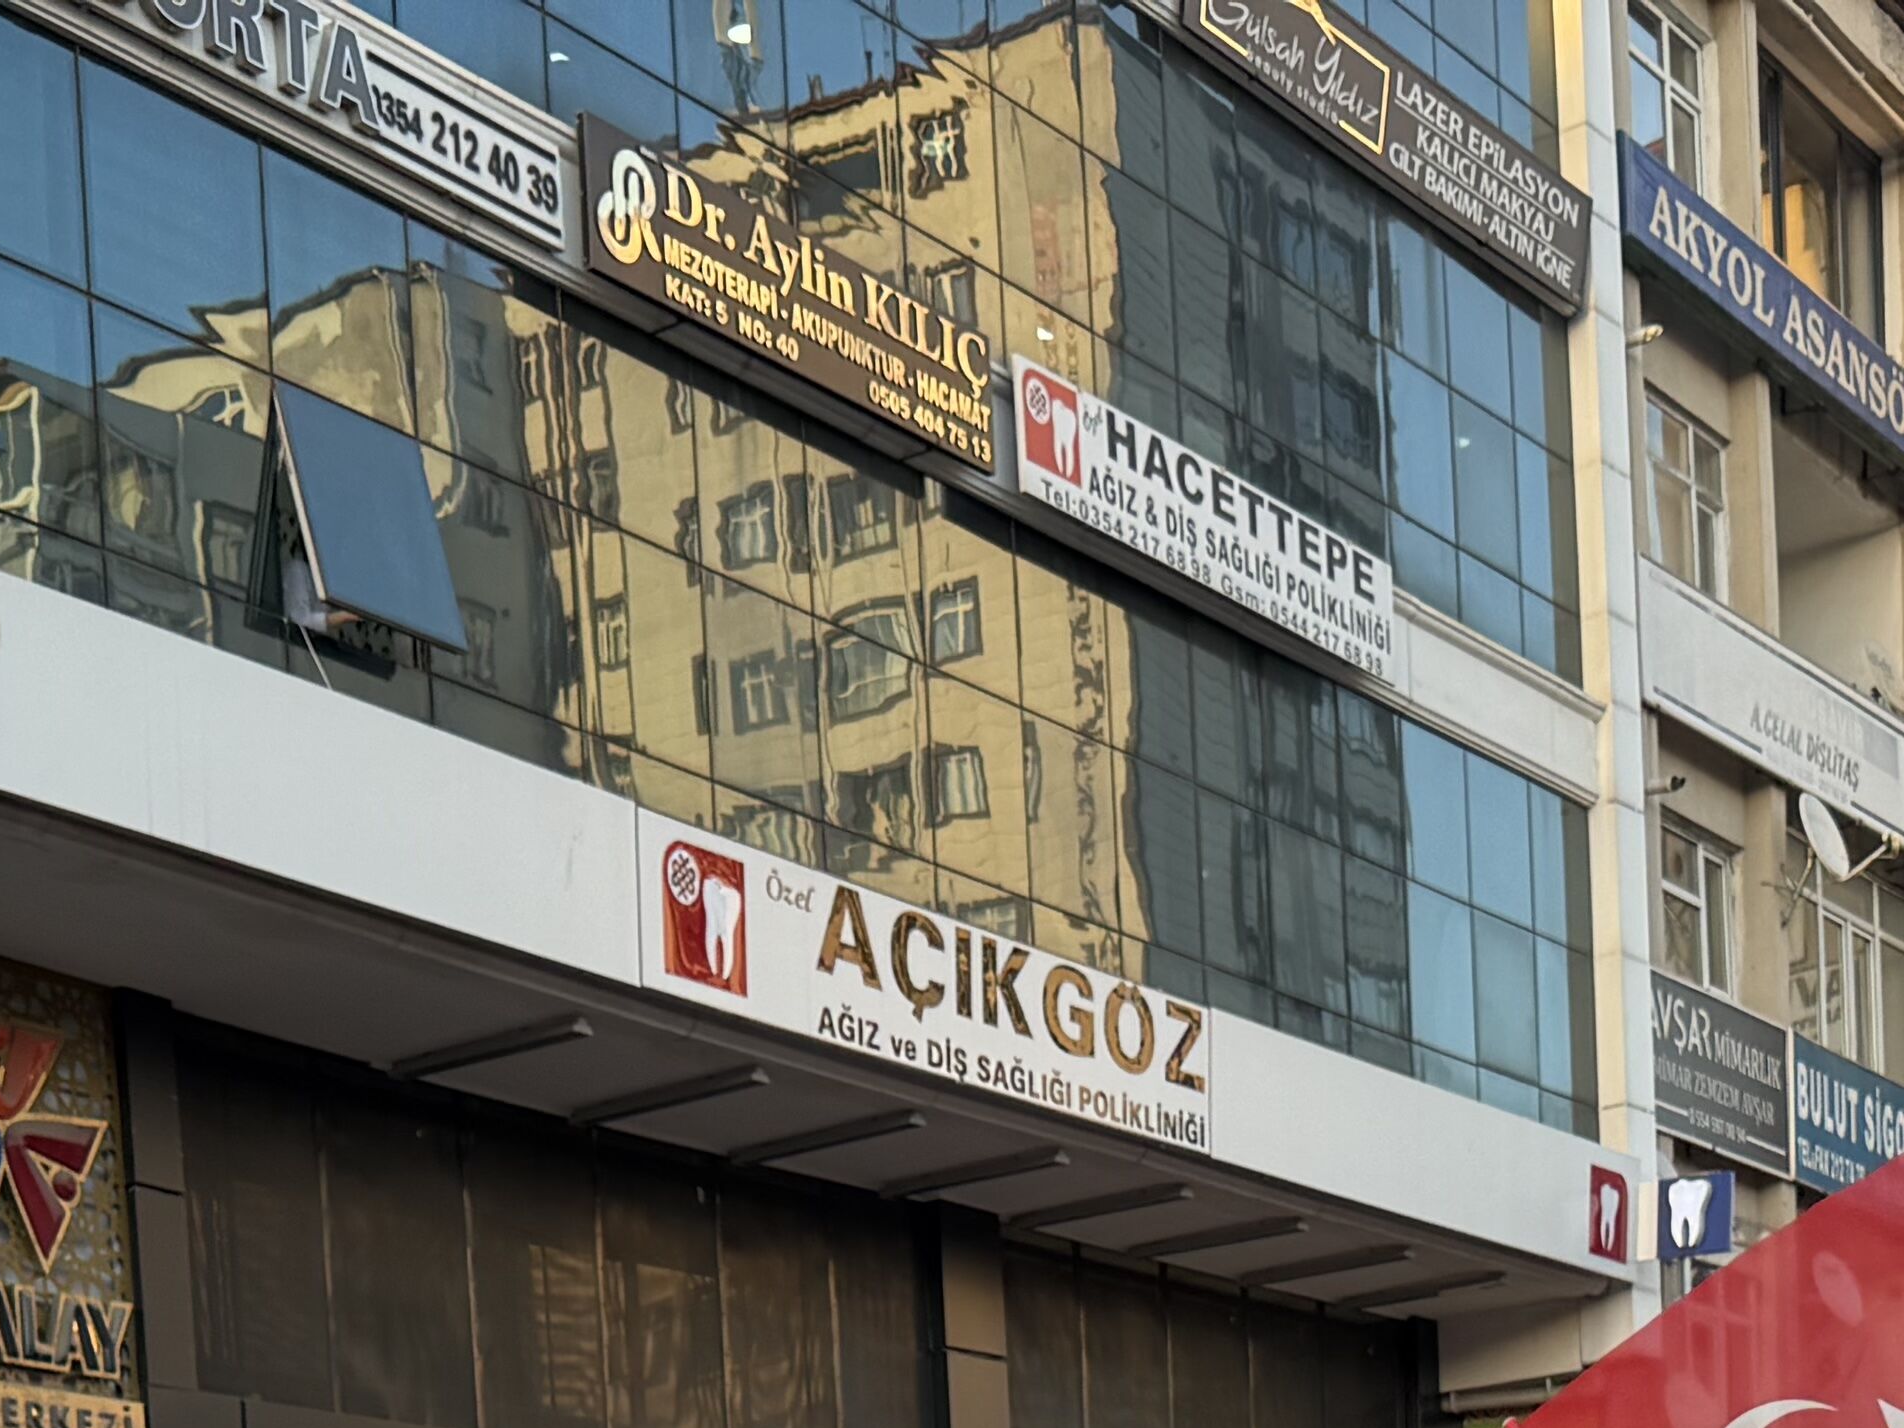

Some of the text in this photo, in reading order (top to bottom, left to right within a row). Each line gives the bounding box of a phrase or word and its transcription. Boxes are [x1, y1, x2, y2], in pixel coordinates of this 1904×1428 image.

[430, 111, 481, 175] 212
[487, 143, 520, 194] 40
[526, 164, 559, 214] 39
[1388, 142, 1421, 181] CİLT
[1424, 165, 1483, 226] BAKIMI
[1488, 215, 1534, 262] ALTIN
[1396, 71, 1580, 228] LAZER EPİLASYON
[1417, 124, 1556, 242] KALICI MAKYAJ
[661, 161, 989, 400] Dr. Aylin KILIÇ
[1649, 184, 1777, 329] AKYOL
[663, 234, 991, 433] MEZOTERAPİ AKUPUNKTUR HACAMAT
[716, 302, 729, 326] 5
[737, 315, 774, 349] NO:
[776, 332, 799, 362] 40
[913, 405, 945, 439] 404
[947, 420, 968, 451] 75
[971, 435, 993, 463] 13
[1089, 465, 1392, 656] AĞIZ & DİŞ SAĞLIĞI POLİKLİNİĞİ
[1105, 408, 1376, 606] HACETTEPE
[1128, 524, 1160, 558] 217
[1312, 623, 1340, 654] 217
[764, 866, 1207, 1094] Özel AÇIKGÖZ
[817, 1003, 1207, 1149] AĞIZ ve DİŞ SAĞLIĞI POLİKLİNİĞİ
[1713, 1030, 1782, 1092] MİMARLIK
[1797, 1061, 1859, 1144] BULUT
